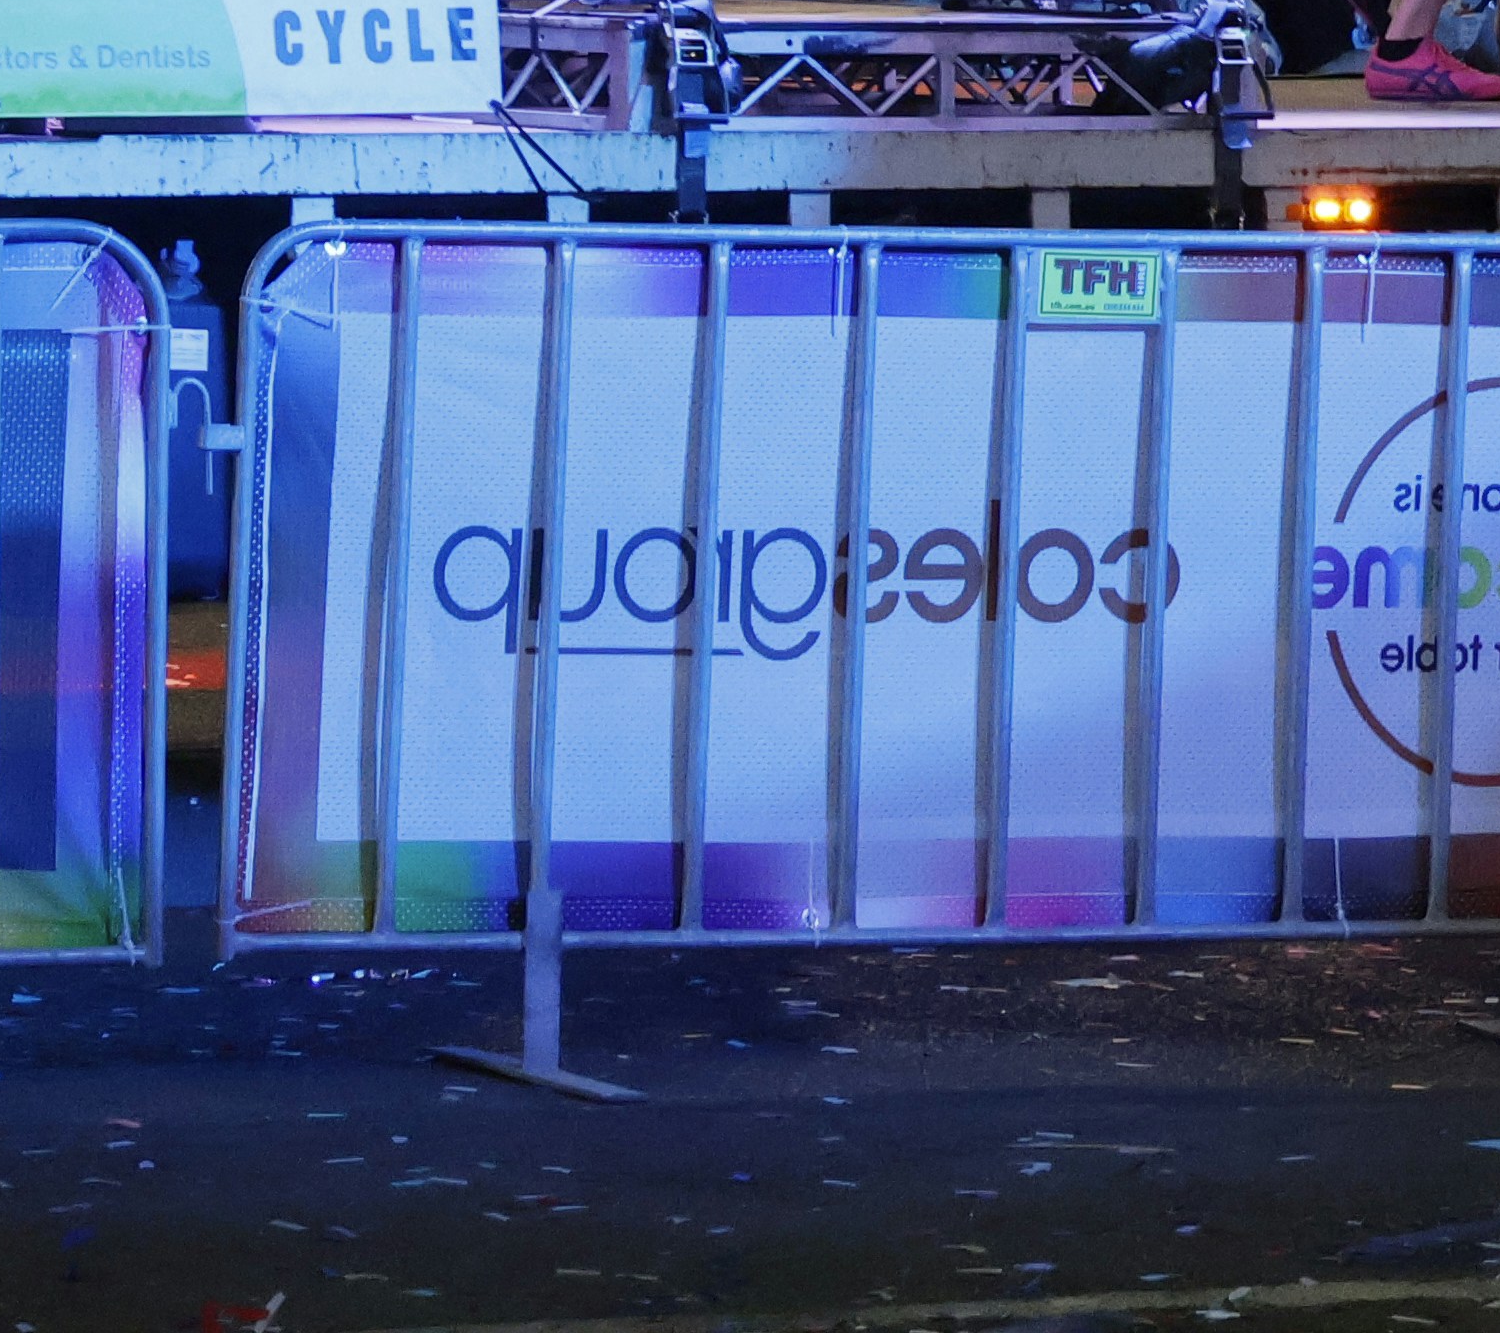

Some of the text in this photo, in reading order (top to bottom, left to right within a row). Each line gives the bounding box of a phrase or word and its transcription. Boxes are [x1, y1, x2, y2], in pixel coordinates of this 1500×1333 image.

[273, 6, 478, 66] CYCLE
[69, 44, 90, 70] &
[98, 43, 212, 70] Dentists
[1053, 257, 1139, 296] TFH
